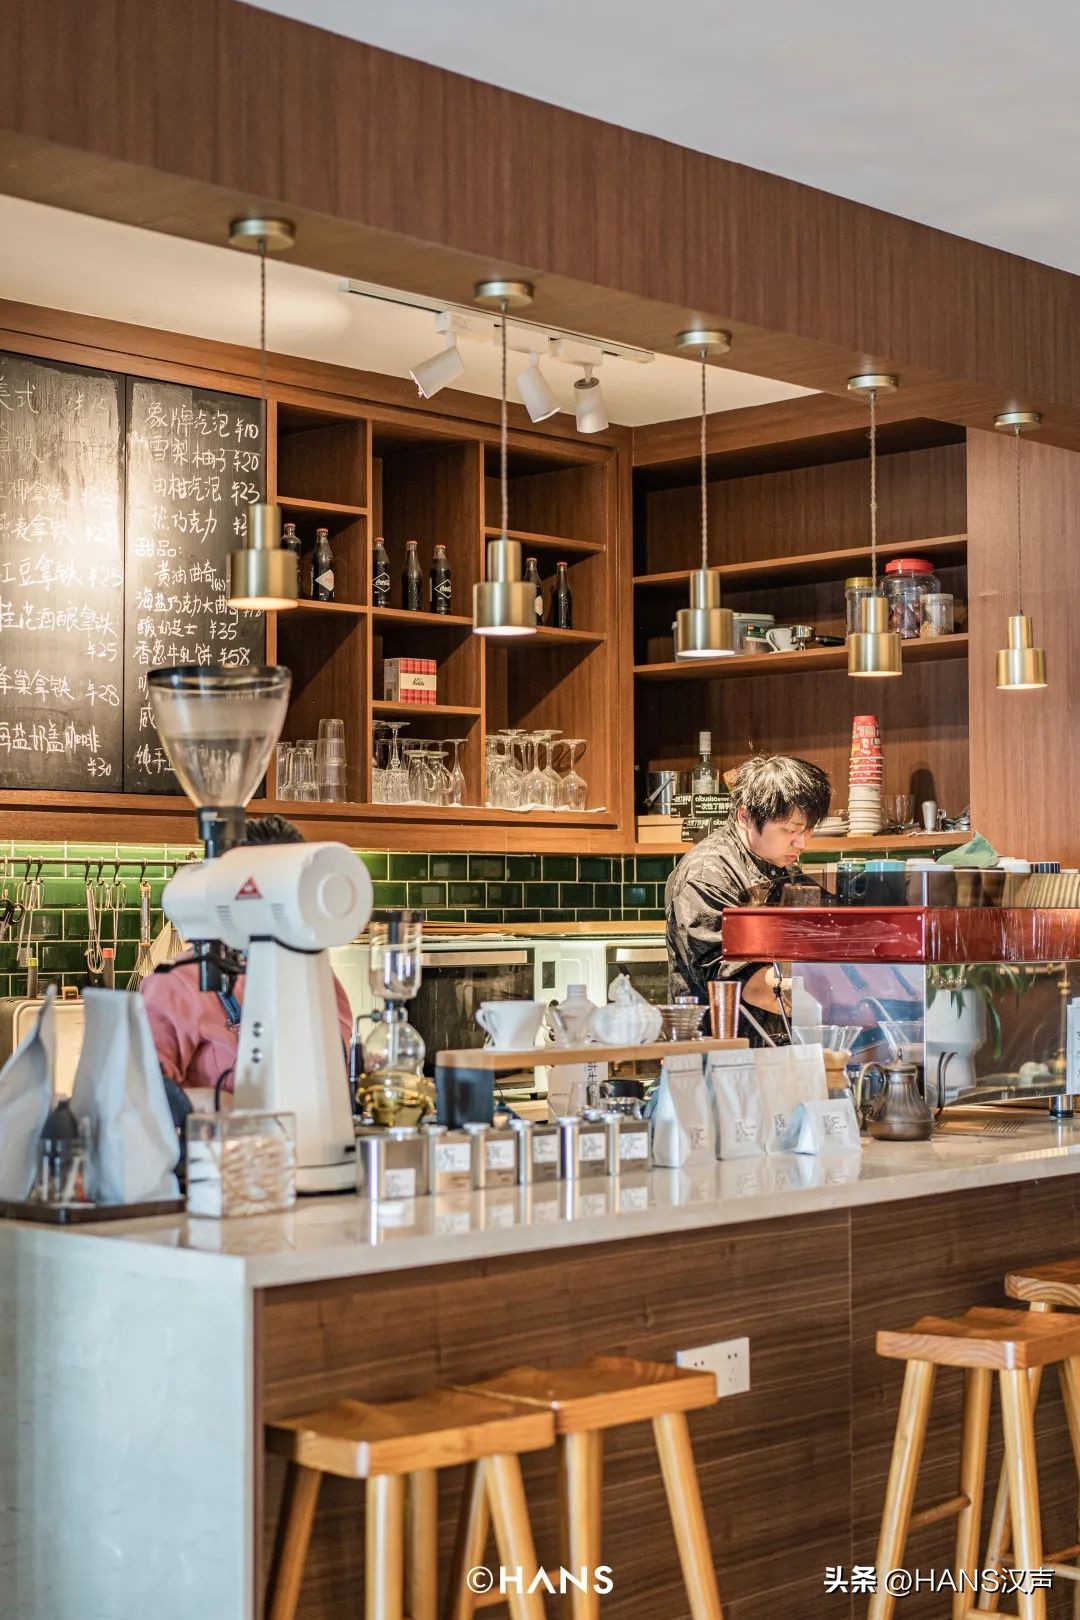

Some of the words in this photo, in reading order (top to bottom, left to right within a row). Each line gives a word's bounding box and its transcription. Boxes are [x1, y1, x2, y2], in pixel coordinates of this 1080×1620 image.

[235, 418, 259, 442] ¥10
[149, 435, 226, 472] 雪梨柚子
[233, 449, 259, 472] ¥20
[209, 619, 237, 640] ¥35
[87, 641, 118, 662] ¥25
[217, 648, 250, 666] ¥58
[85, 679, 120, 707] ¥28
[87, 758, 112, 778] ¥30
